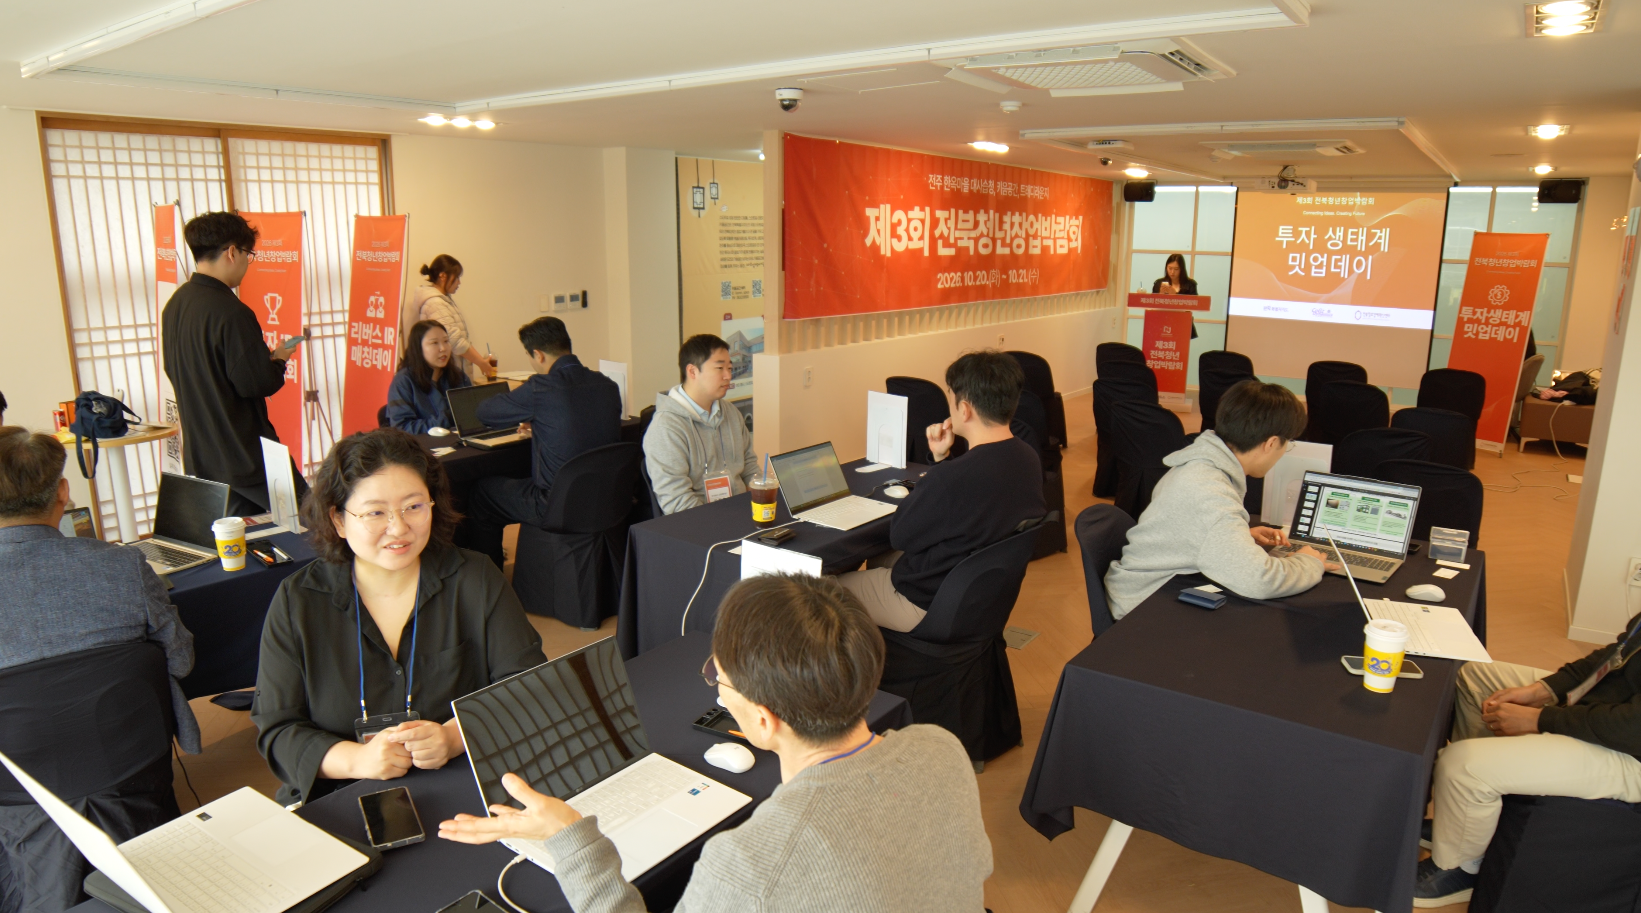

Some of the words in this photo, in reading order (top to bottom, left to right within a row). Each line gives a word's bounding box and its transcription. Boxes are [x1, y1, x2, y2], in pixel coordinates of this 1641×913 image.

[928, 173, 943, 190] 전주
[943, 175, 970, 193] 한옥마을
[970, 178, 995, 196] 대사습청,
[1296, 196, 1313, 205] 제3회
[1315, 196, 1375, 206] 전북청년창업박람회
[865, 204, 930, 257] 제3회
[934, 208, 1083, 256] 전북청년창업박람회
[1275, 225, 1317, 250] 투자
[1324, 226, 1390, 252] 생태계
[1288, 252, 1373, 280] 밋업데이
[1459, 305, 1531, 327] 투자생태계
[262, 330, 278, 351] 자
[351, 321, 382, 345] 리버스
[384, 326, 395, 346] IR
[1463, 322, 1520, 343] 밋업데이
[1149, 350, 1180, 361] 전북청년
[1155, 340, 1176, 350] 제3회
[351, 344, 392, 372] 매칭데이
[284, 358, 298, 384] 회
[1370, 656, 1392, 671] 20
